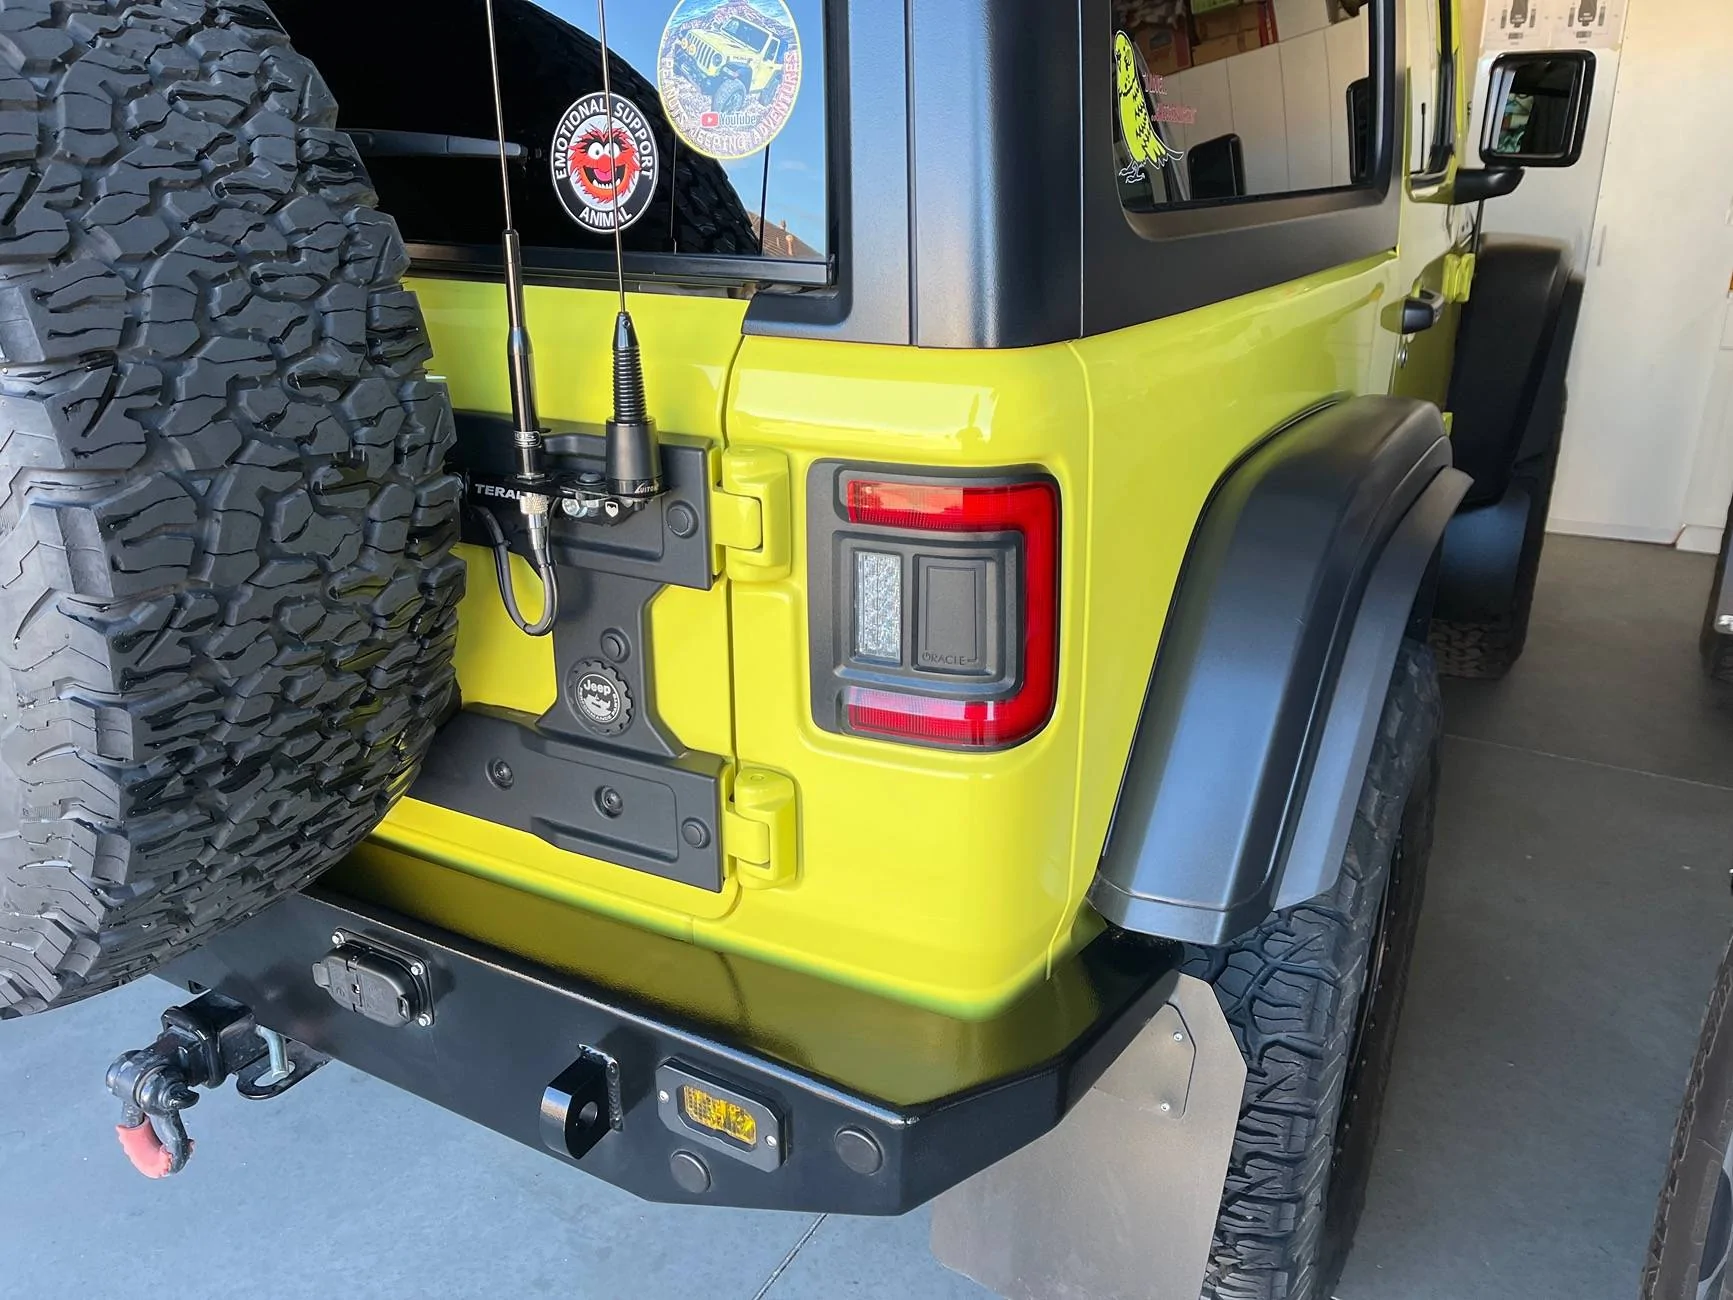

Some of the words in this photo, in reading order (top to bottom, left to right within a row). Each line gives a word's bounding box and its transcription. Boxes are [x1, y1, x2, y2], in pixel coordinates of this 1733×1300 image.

[719, 113, 757, 125] YouTube
[555, 98, 607, 180] EMOTIONAL
[614, 102, 654, 180] SUPPORT
[583, 679, 611, 696] Jeep
